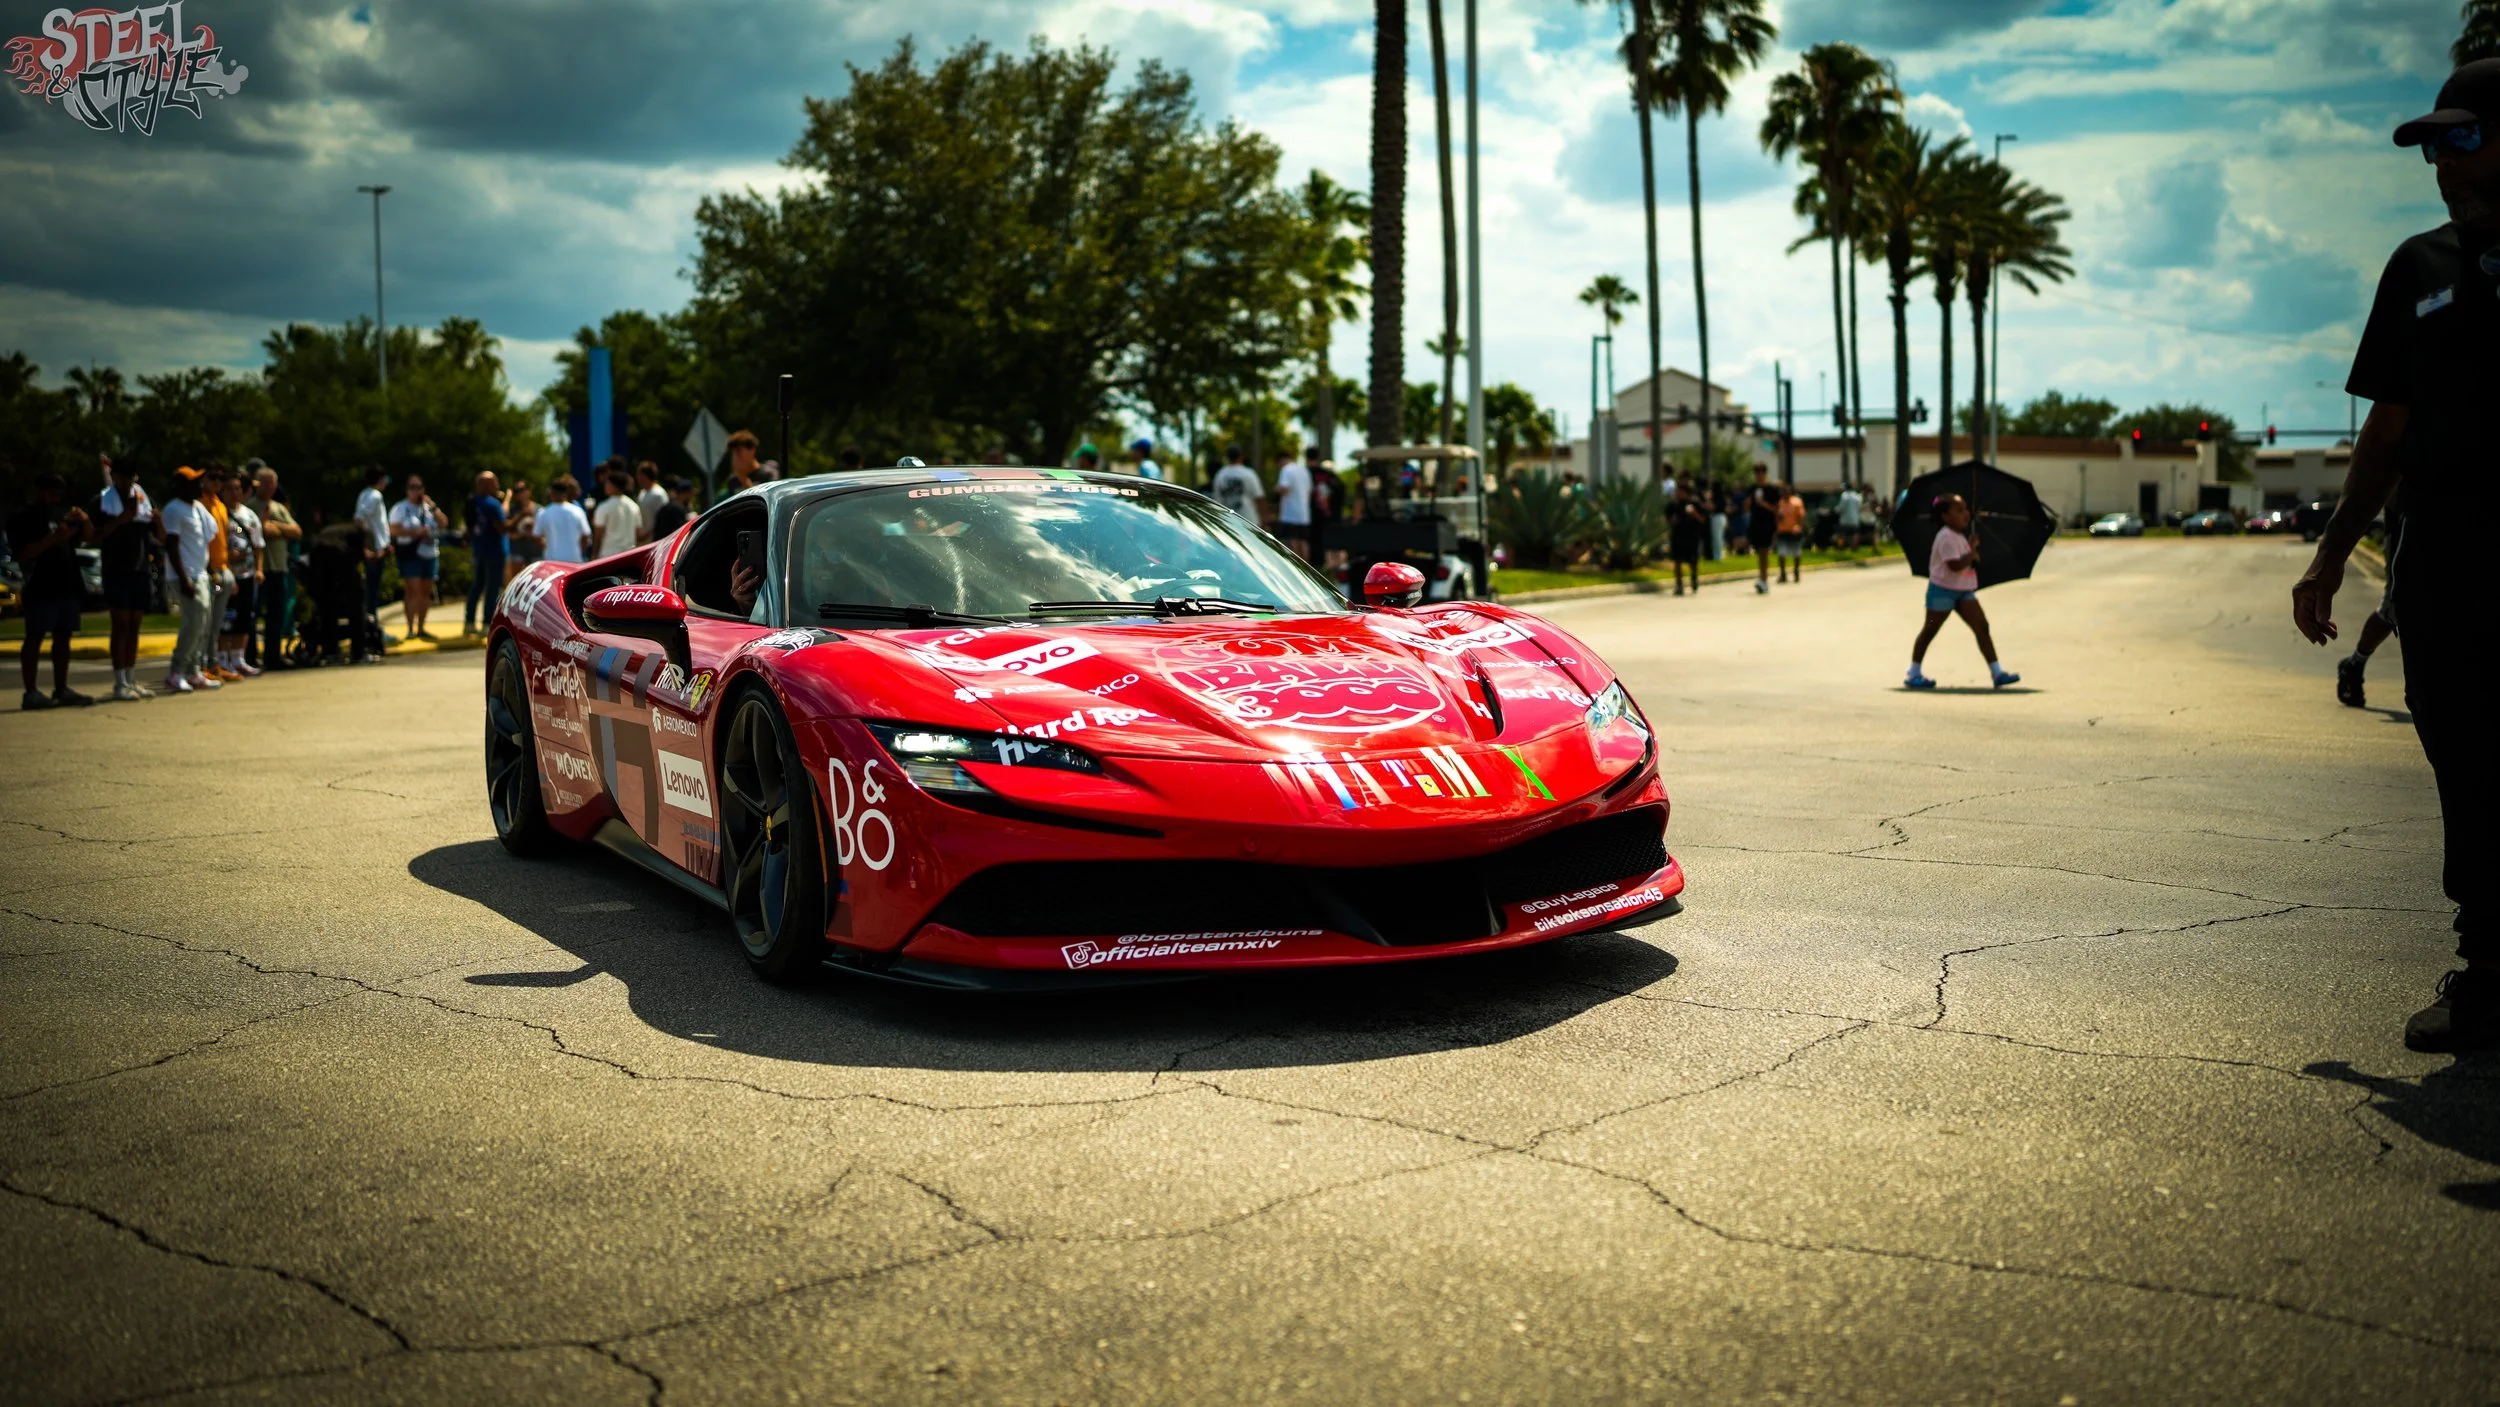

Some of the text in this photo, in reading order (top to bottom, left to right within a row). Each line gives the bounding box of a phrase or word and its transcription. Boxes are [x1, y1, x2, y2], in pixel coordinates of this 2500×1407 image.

[908, 483, 1139, 499] GUMBALL 3000
[603, 589, 665, 606] mph club
[663, 715, 697, 738] AEROMEXICO
[555, 752, 595, 782] MONEX
[663, 762, 705, 801] Lenovo
[1521, 883, 1620, 914] @GuyLagace
[1534, 887, 1665, 932] tiktoksensation45
[1117, 929, 1323, 944] @boostandbuns
[1090, 938, 1281, 964] officialteamxiv
